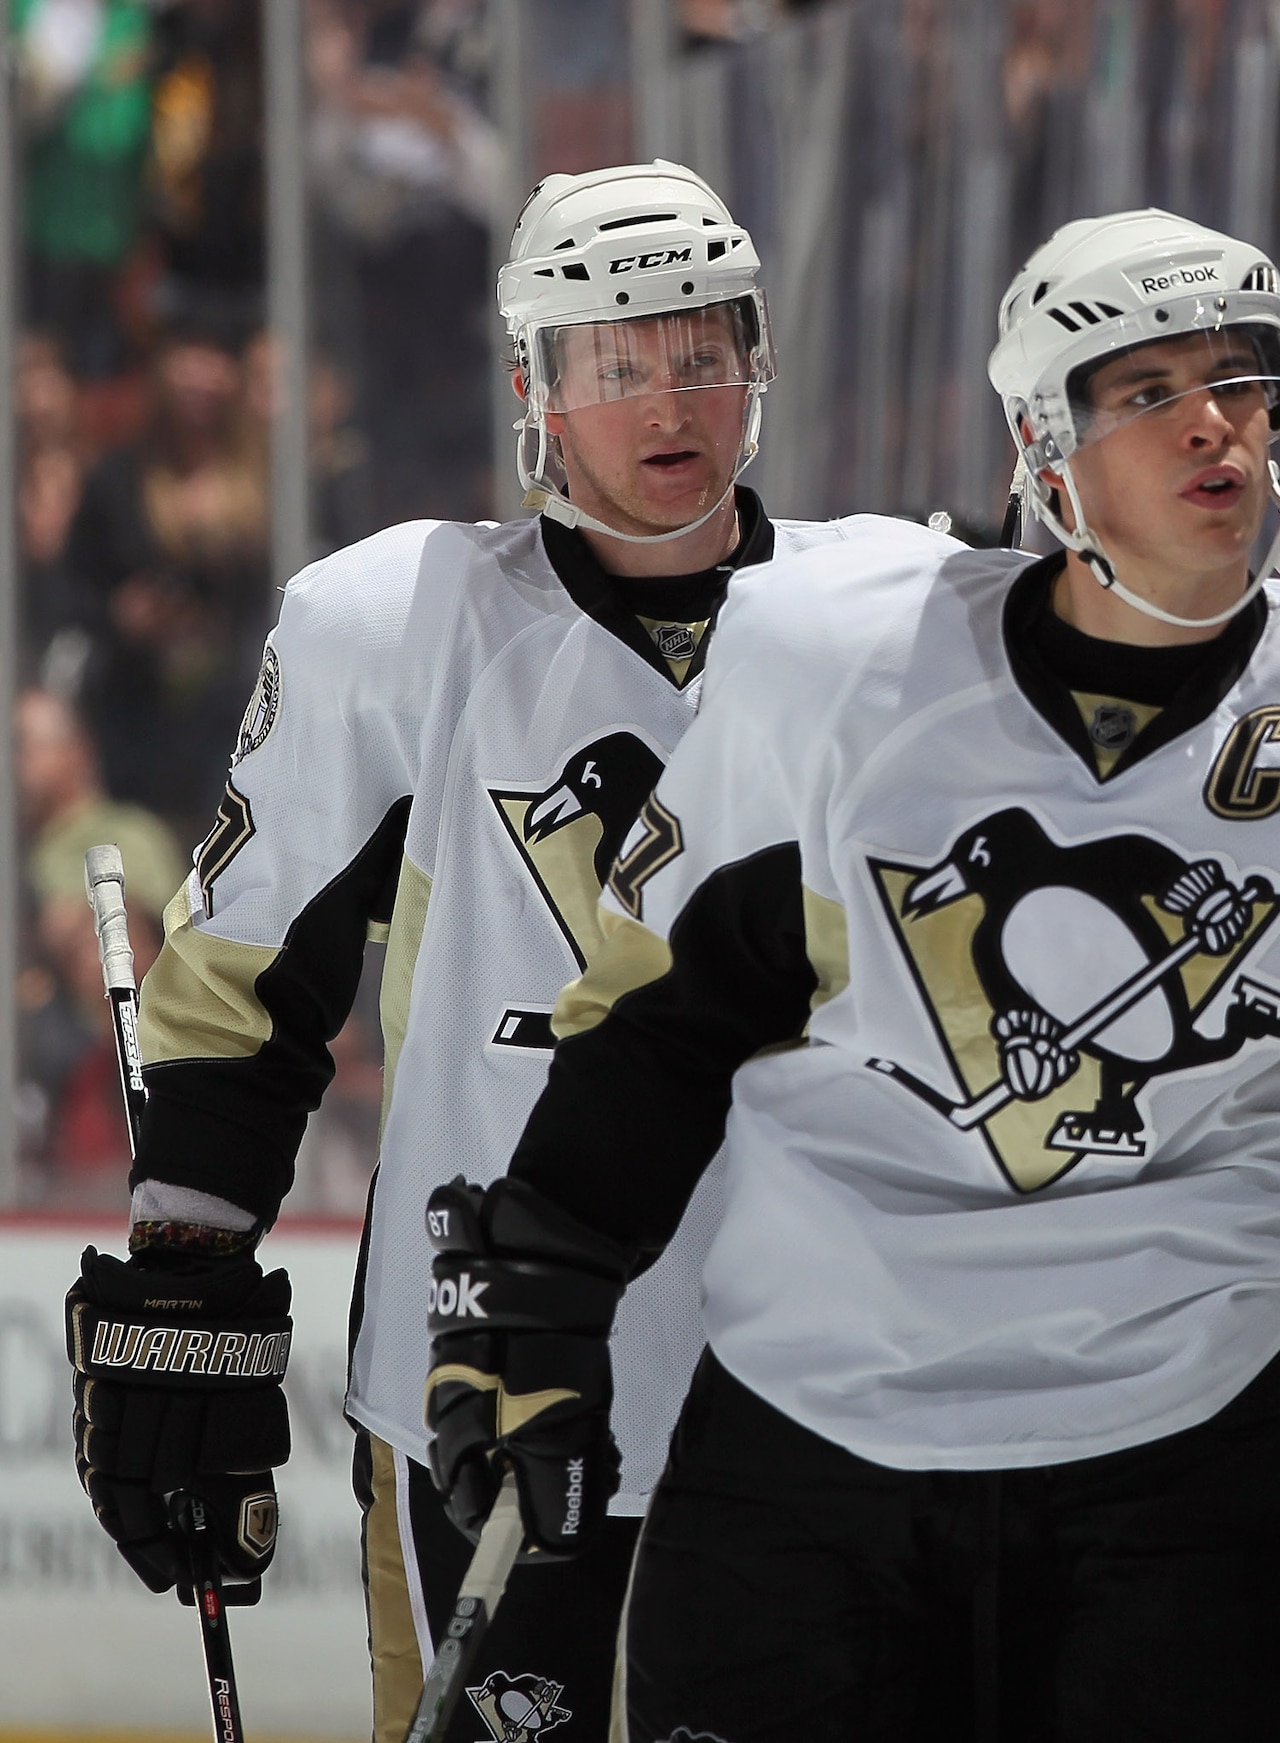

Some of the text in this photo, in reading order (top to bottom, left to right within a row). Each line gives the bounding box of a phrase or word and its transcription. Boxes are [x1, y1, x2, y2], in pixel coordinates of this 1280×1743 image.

[608, 247, 692, 275] CCM
[1140, 265, 1220, 295] Reebok
[664, 632, 689, 651] NHL
[427, 1208, 450, 1238] 87
[143, 1298, 203, 1310] MARTIN
[91, 1320, 291, 1378] WARRIOR
[561, 1457, 584, 1536] Reebok
